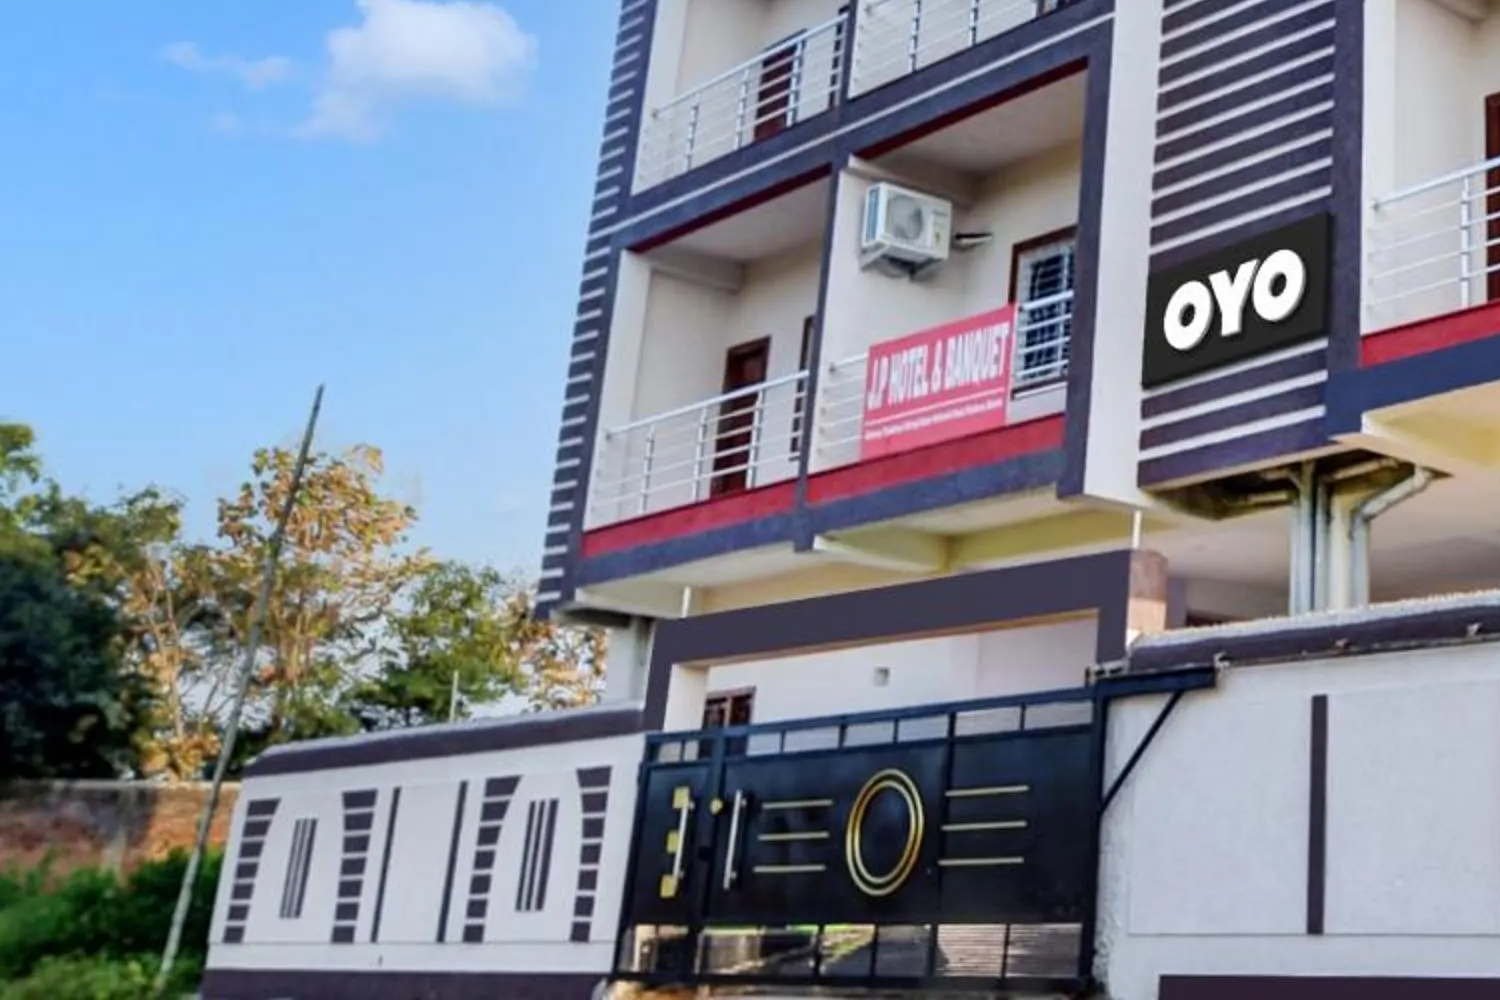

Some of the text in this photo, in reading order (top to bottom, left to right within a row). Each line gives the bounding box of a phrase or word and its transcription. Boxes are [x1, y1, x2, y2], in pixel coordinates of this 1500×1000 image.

[1164, 249, 1306, 351] OYO
[888, 345, 929, 407] HOTEL
[931, 339, 943, 393] &
[944, 322, 1010, 389] BANQUET
